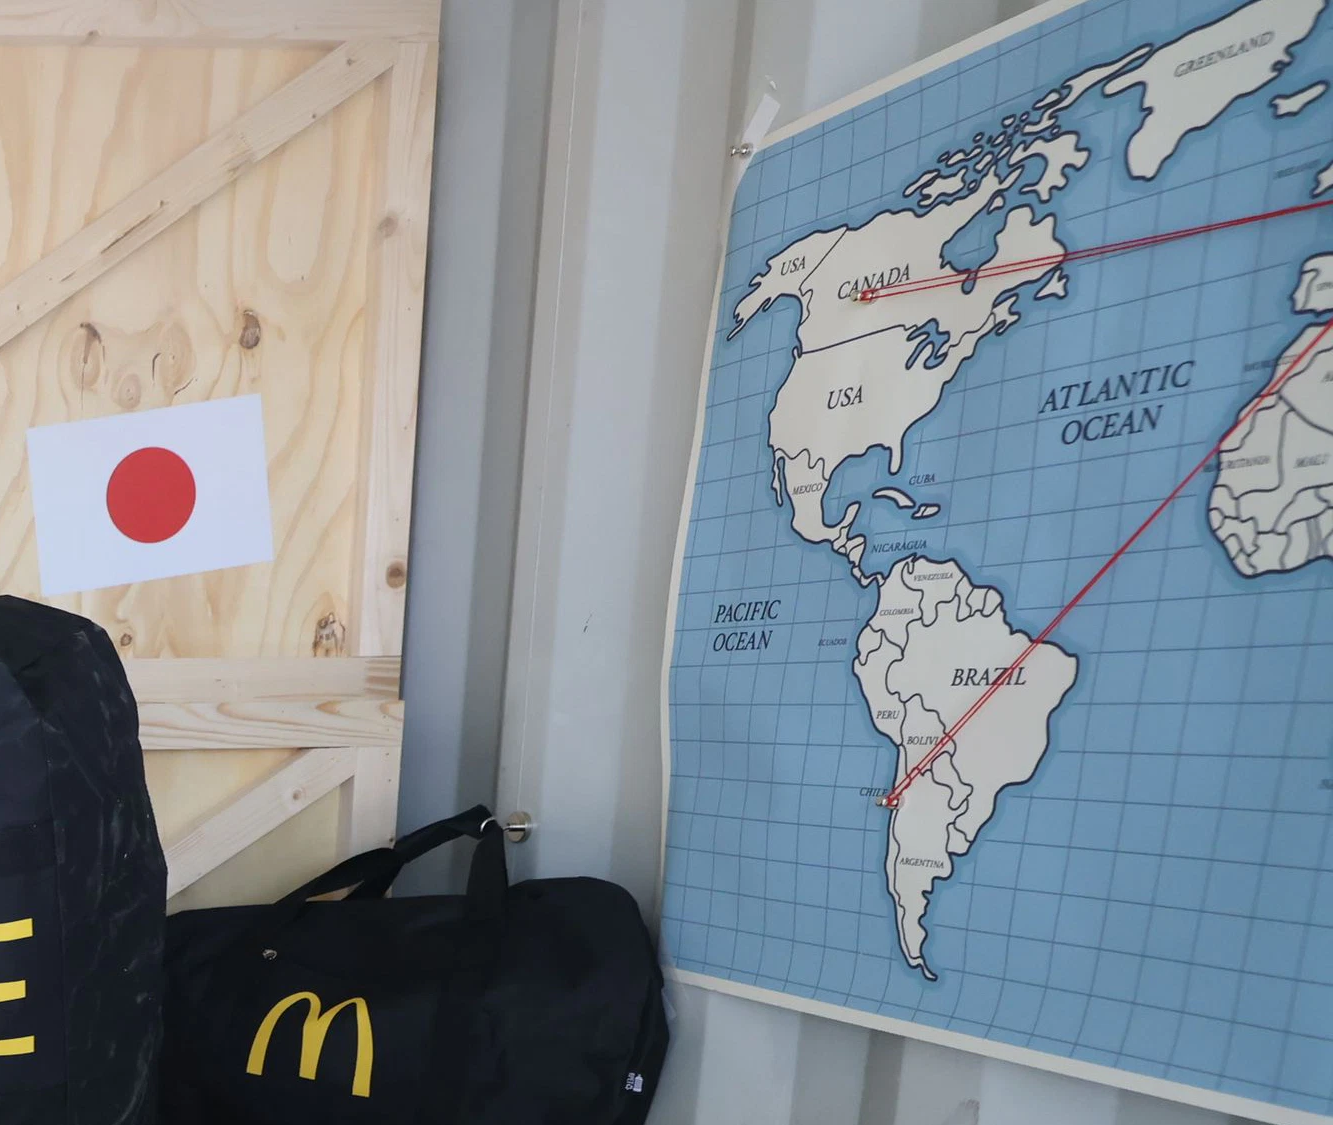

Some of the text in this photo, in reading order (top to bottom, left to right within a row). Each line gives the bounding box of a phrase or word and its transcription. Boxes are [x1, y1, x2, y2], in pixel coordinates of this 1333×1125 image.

[1174, 30, 1275, 78] GREENLAND
[780, 255, 807, 276] USA
[837, 263, 911, 300] CANADA
[1038, 360, 1196, 415] ATLANTIC
[827, 384, 863, 410] USA
[1061, 404, 1164, 445] OCEAN
[908, 473, 936, 486] CUBA
[791, 482, 824, 496] MEXICO
[871, 540, 928, 554] NICARAGUA
[913, 571, 955, 582] VENEZUELA
[714, 600, 782, 624] PACIFIC
[879, 607, 915, 617] COLOMBIA
[712, 630, 774, 652] OCEAN
[817, 637, 848, 648] ECUADOR
[950, 666, 1028, 687] BRAZIL
[876, 709, 900, 720] PERU
[859, 786, 889, 798] CHILE
[899, 856, 946, 870] ARGENTINA
